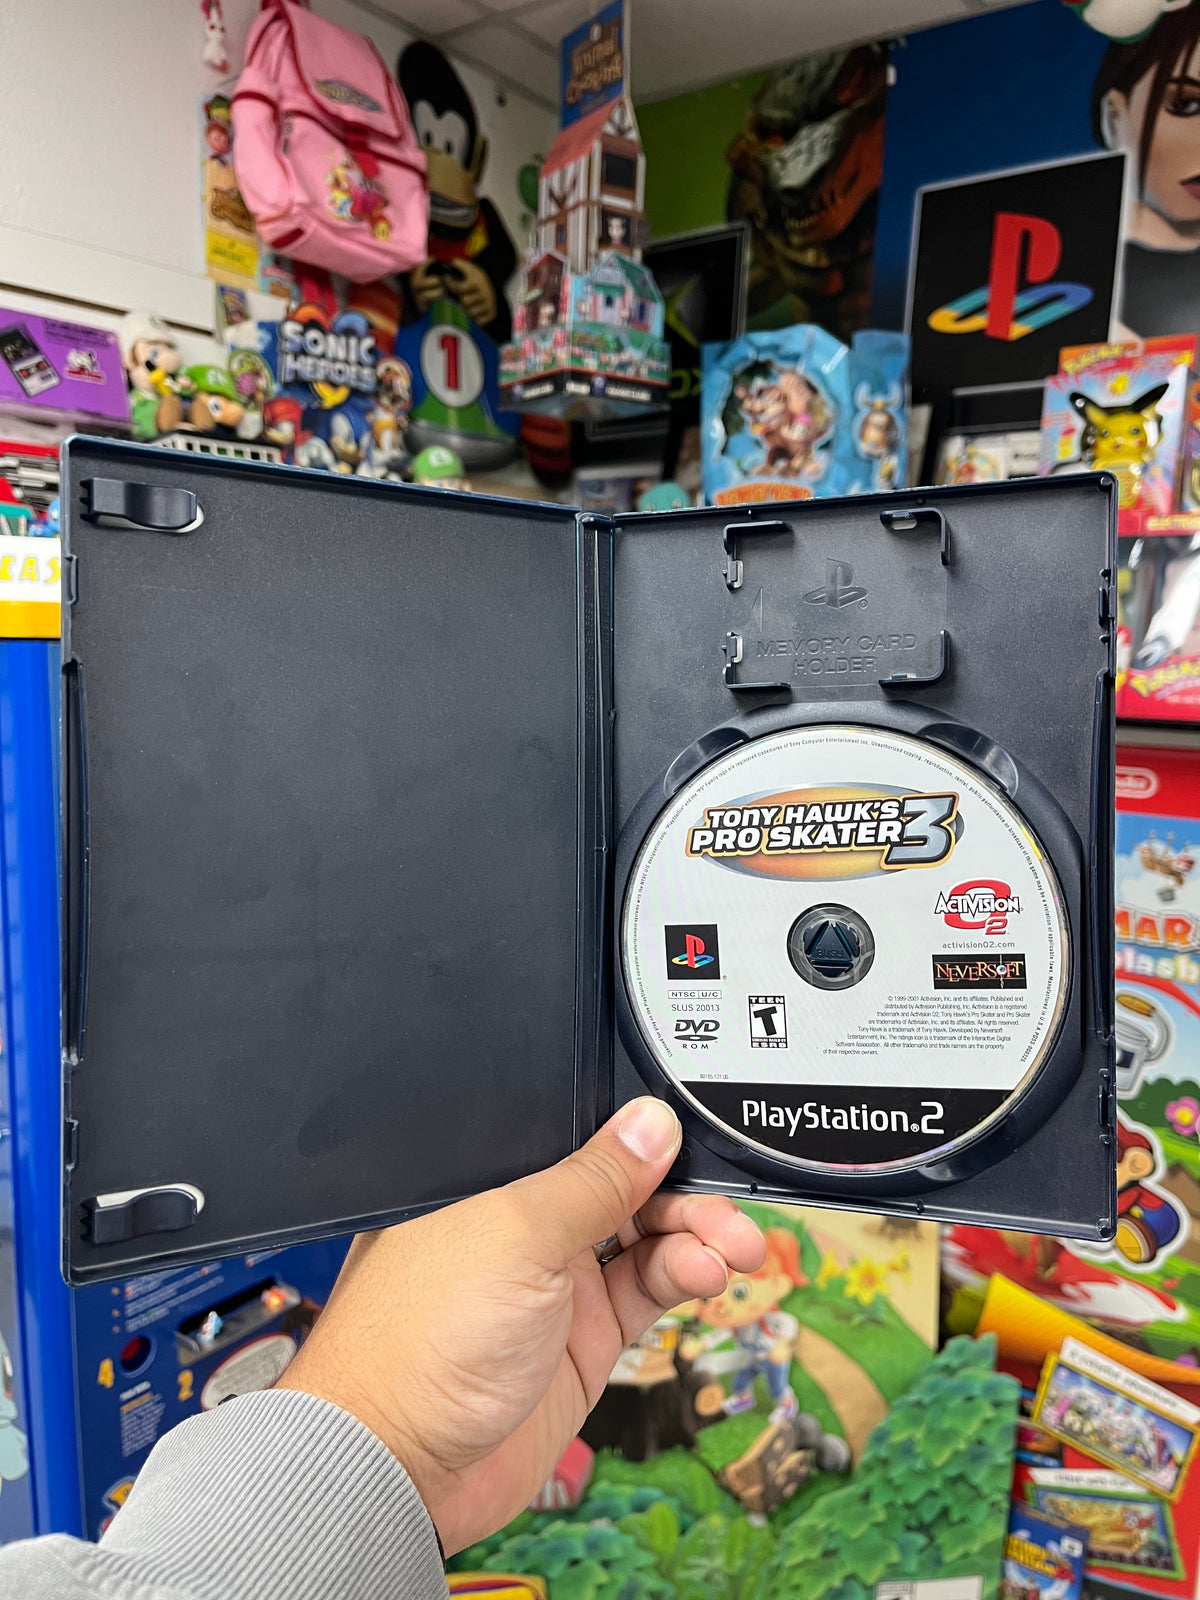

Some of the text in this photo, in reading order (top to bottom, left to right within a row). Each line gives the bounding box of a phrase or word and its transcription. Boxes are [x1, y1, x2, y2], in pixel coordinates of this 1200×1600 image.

[283, 320, 376, 366] SONIC
[284, 352, 377, 392] HEROES
[438, 333, 459, 391] 1
[757, 634, 917, 658] MEMORY CARD
[794, 656, 878, 676] HOLDER
[734, 753, 757, 767] registered
[757, 745, 782, 756] trademarks
[707, 800, 900, 829] TONY HAWK'S
[981, 797, 1005, 823] performance
[691, 794, 957, 865] PRO SKATER 3
[1008, 827, 1024, 850] broadcast
[1029, 865, 1038, 879] game
[1042, 903, 1051, 925] violation
[637, 981, 648, 1006] PlayStation
[1042, 976, 1052, 1009] Manufactured
[675, 1019, 720, 1034] DVD
[753, 1006, 777, 1036] T
[97, 1358, 115, 1389] 4
[177, 1369, 194, 1401] 2
